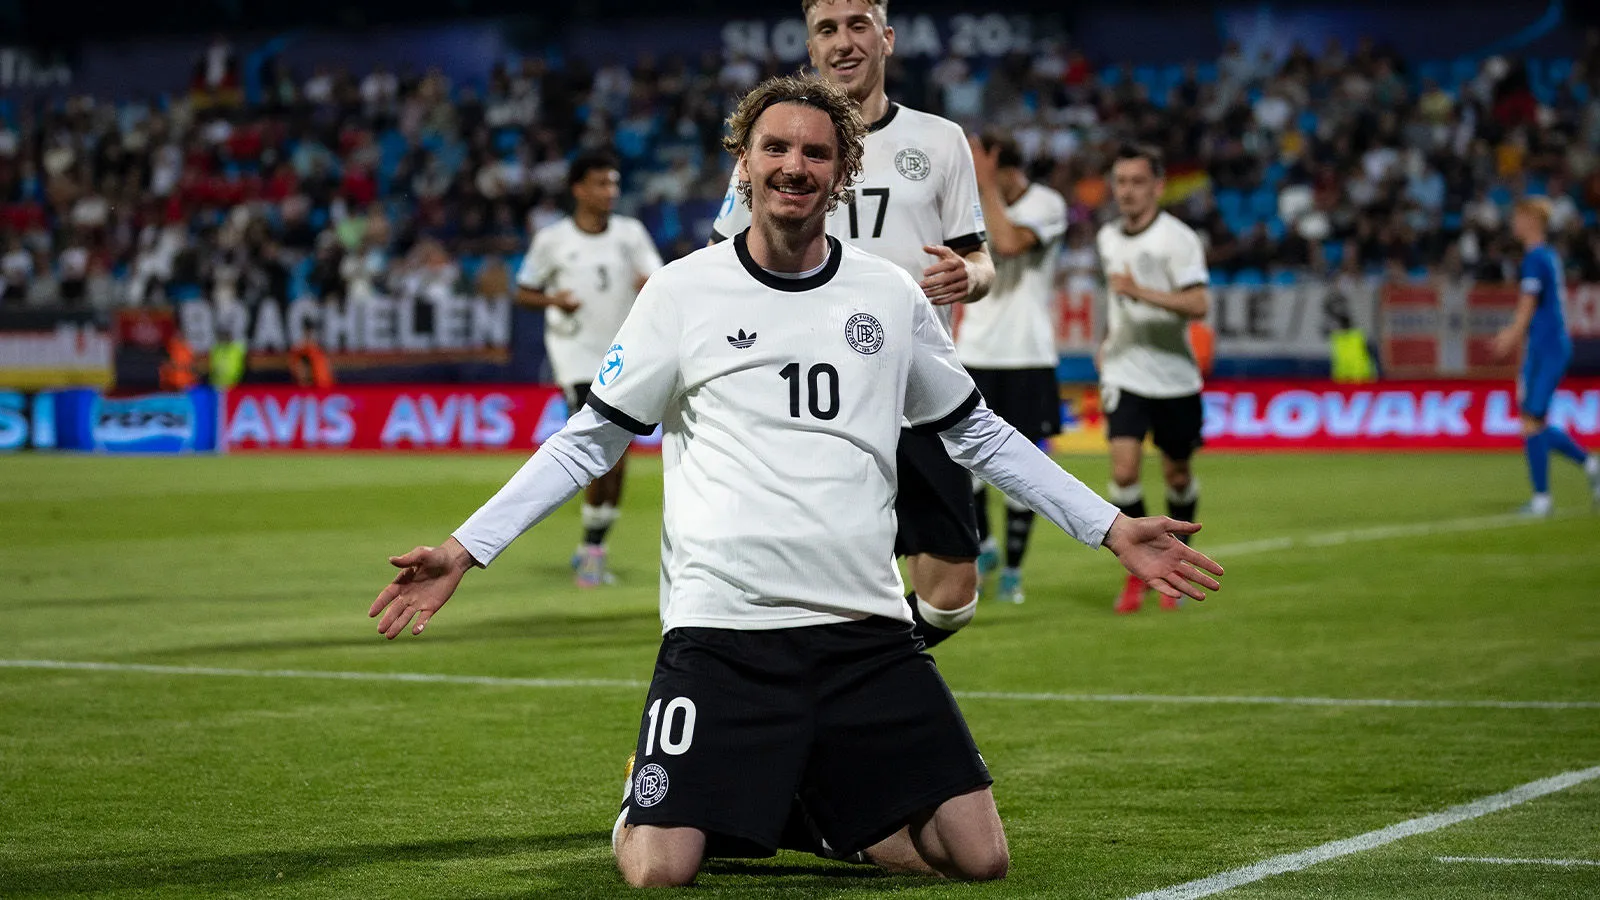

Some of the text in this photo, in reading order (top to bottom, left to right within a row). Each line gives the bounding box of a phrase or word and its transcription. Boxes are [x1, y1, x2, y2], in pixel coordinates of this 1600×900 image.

[720, 14, 942, 61] SLOIA
[845, 187, 890, 239] 17
[596, 264, 610, 292] 3
[779, 362, 840, 420] 10
[1200, 389, 1600, 439] SLOVAK LN
[228, 394, 356, 445] AVIS
[381, 393, 516, 445] AVIS
[645, 696, 697, 757] 10
